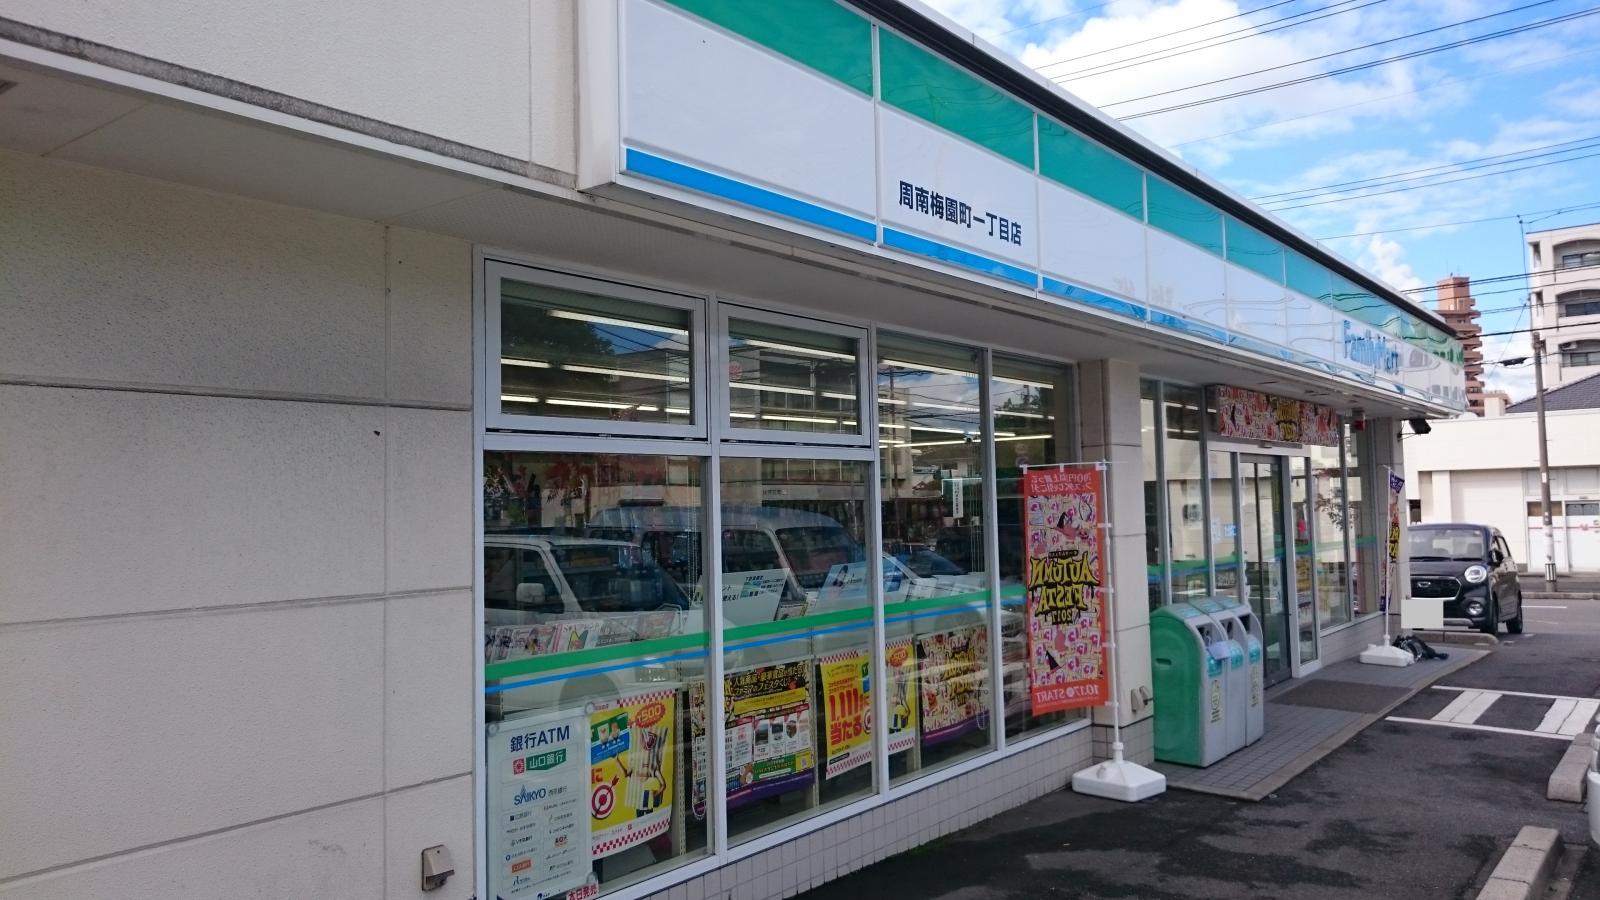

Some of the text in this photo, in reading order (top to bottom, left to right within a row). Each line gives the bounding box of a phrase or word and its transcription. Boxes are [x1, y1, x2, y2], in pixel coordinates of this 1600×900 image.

[899, 180, 1022, 246] 周南梅園町一丁目店
[510, 725, 570, 752] 銀行ATM
[831, 715, 862, 745] 当たる
[529, 751, 564, 768] 山口銀行
[514, 784, 546, 806] SAIKYO
